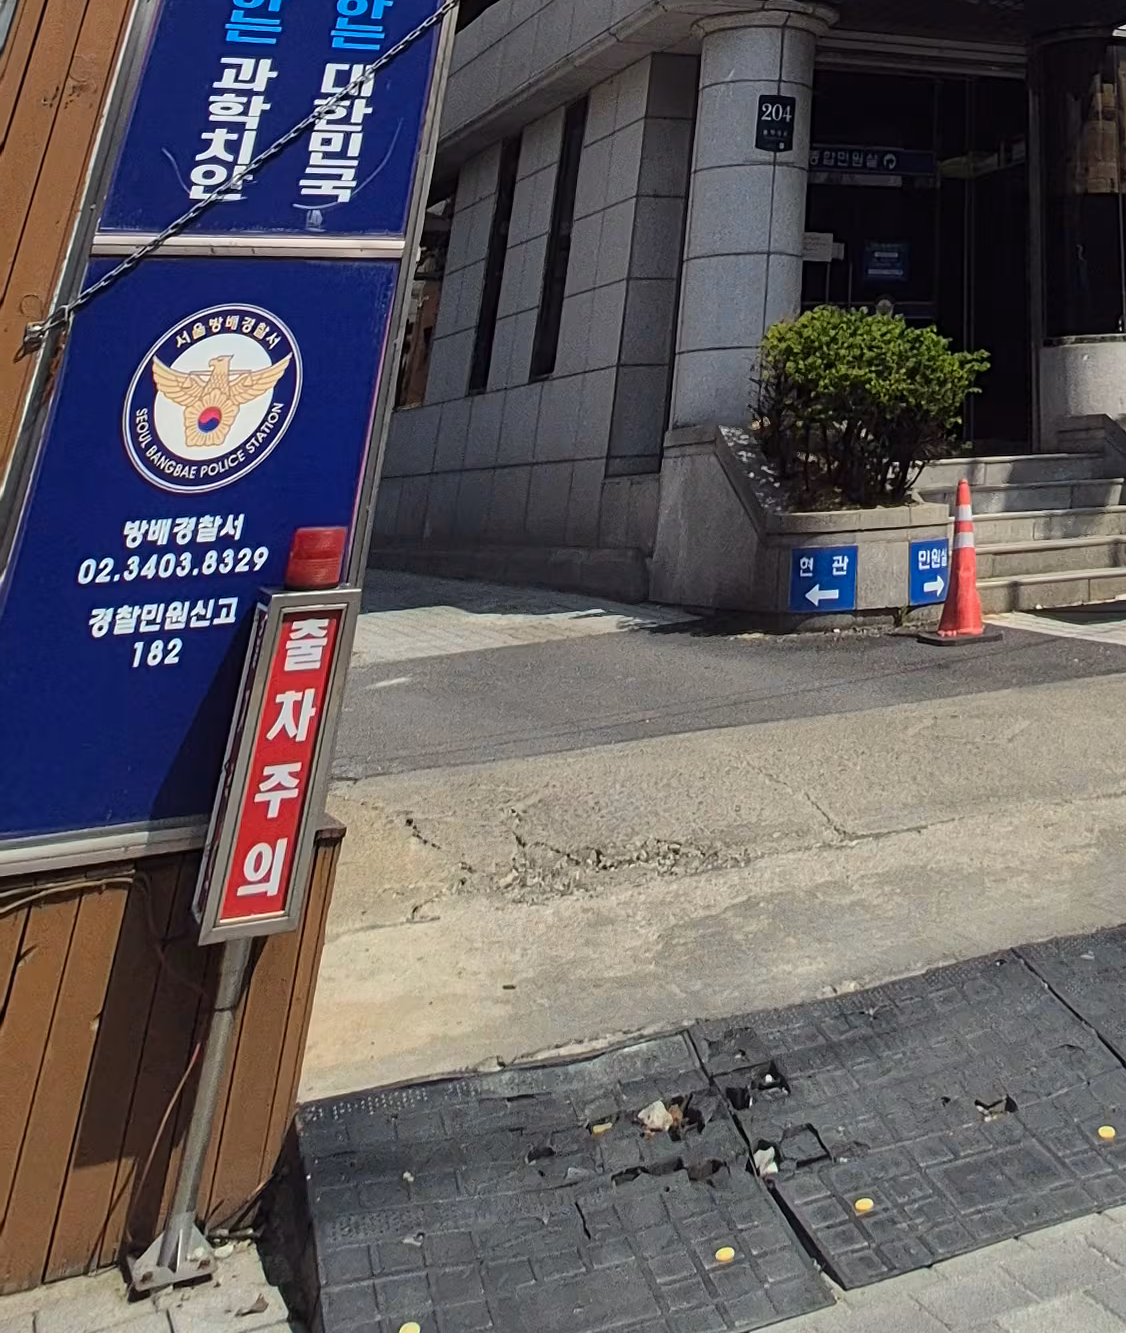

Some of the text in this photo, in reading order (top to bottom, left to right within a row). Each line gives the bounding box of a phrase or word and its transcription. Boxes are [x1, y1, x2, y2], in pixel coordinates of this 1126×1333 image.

[189, 56, 279, 202] 과학치안
[761, 102, 793, 123] 204
[299, 62, 374, 203] 대한민국
[174, 314, 281, 350] 서울방배경찰서
[135, 402, 284, 480] SEOUL BANGBAE POLICE STATION
[123, 513, 245, 549] 방배경찰서
[77, 546, 269, 585] 02.3403.8329
[918, 547, 948, 570] 민원실
[88, 596, 239, 639] 경찰민원신고
[131, 637, 181, 668] 182
